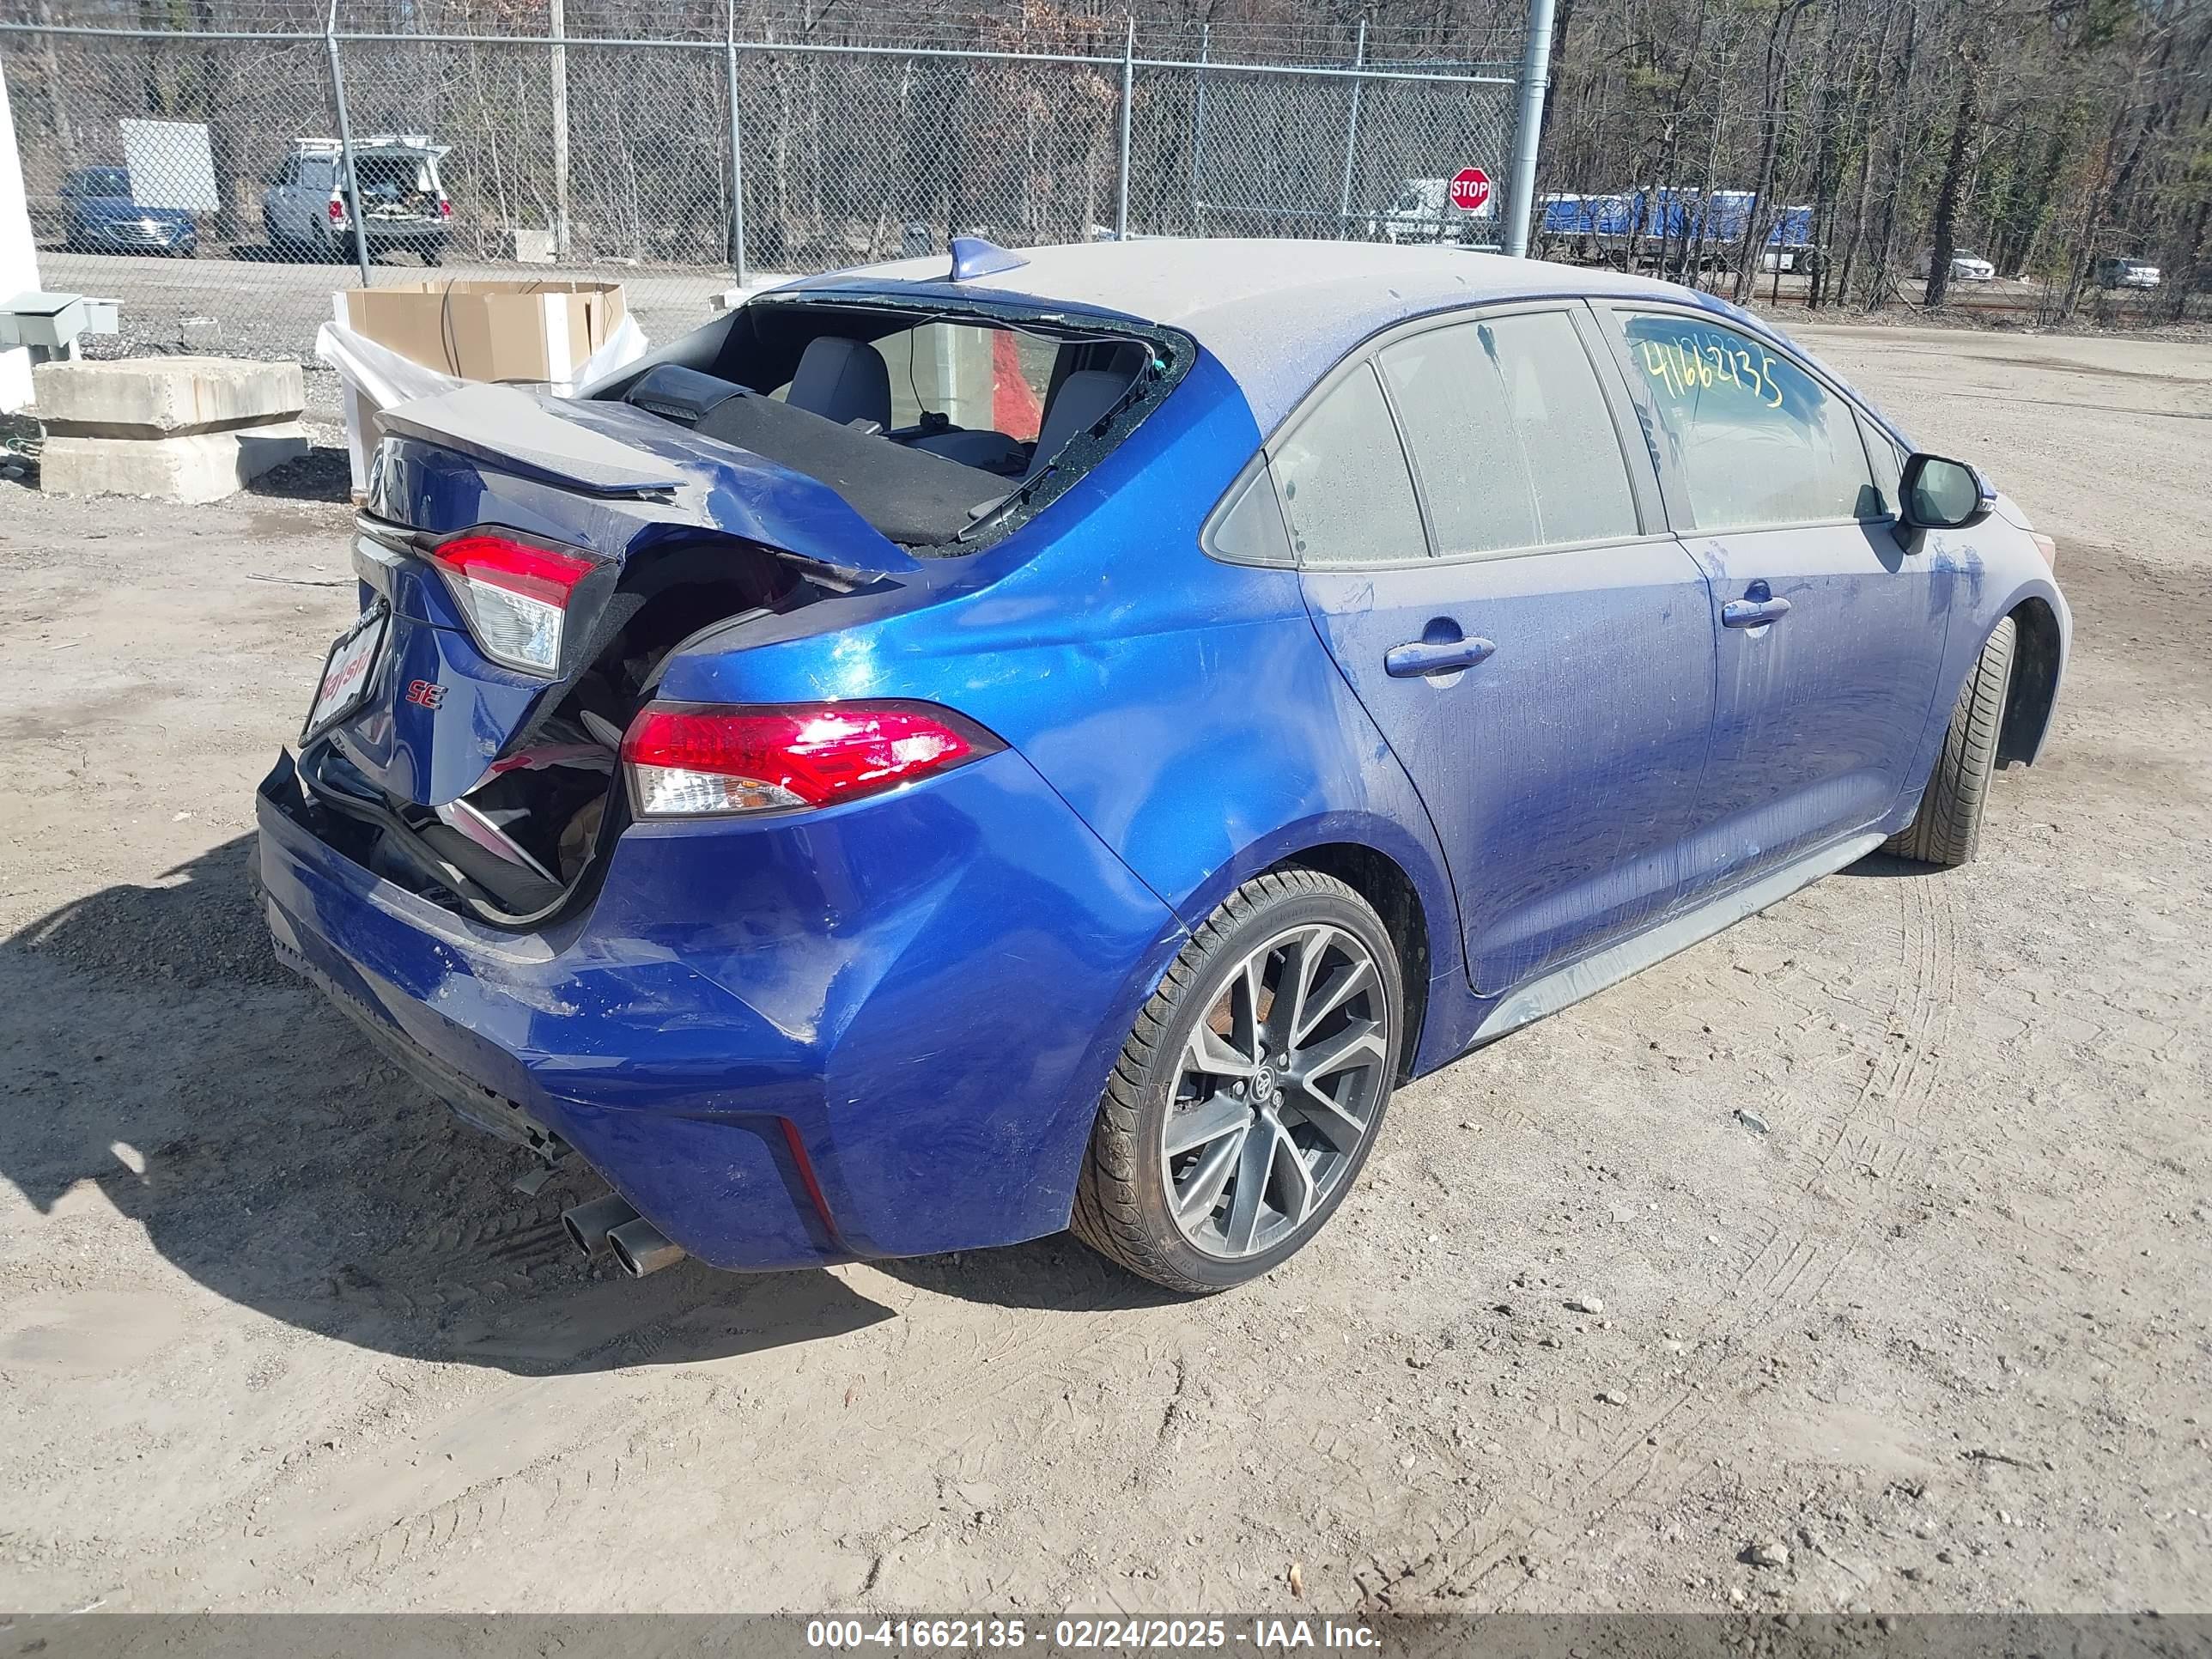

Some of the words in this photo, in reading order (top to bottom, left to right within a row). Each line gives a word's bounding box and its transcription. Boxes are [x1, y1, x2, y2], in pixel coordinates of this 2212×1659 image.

[1452, 180, 1488, 198] STOP
[1642, 342, 1783, 408] 41662135
[405, 679, 447, 709] SE
